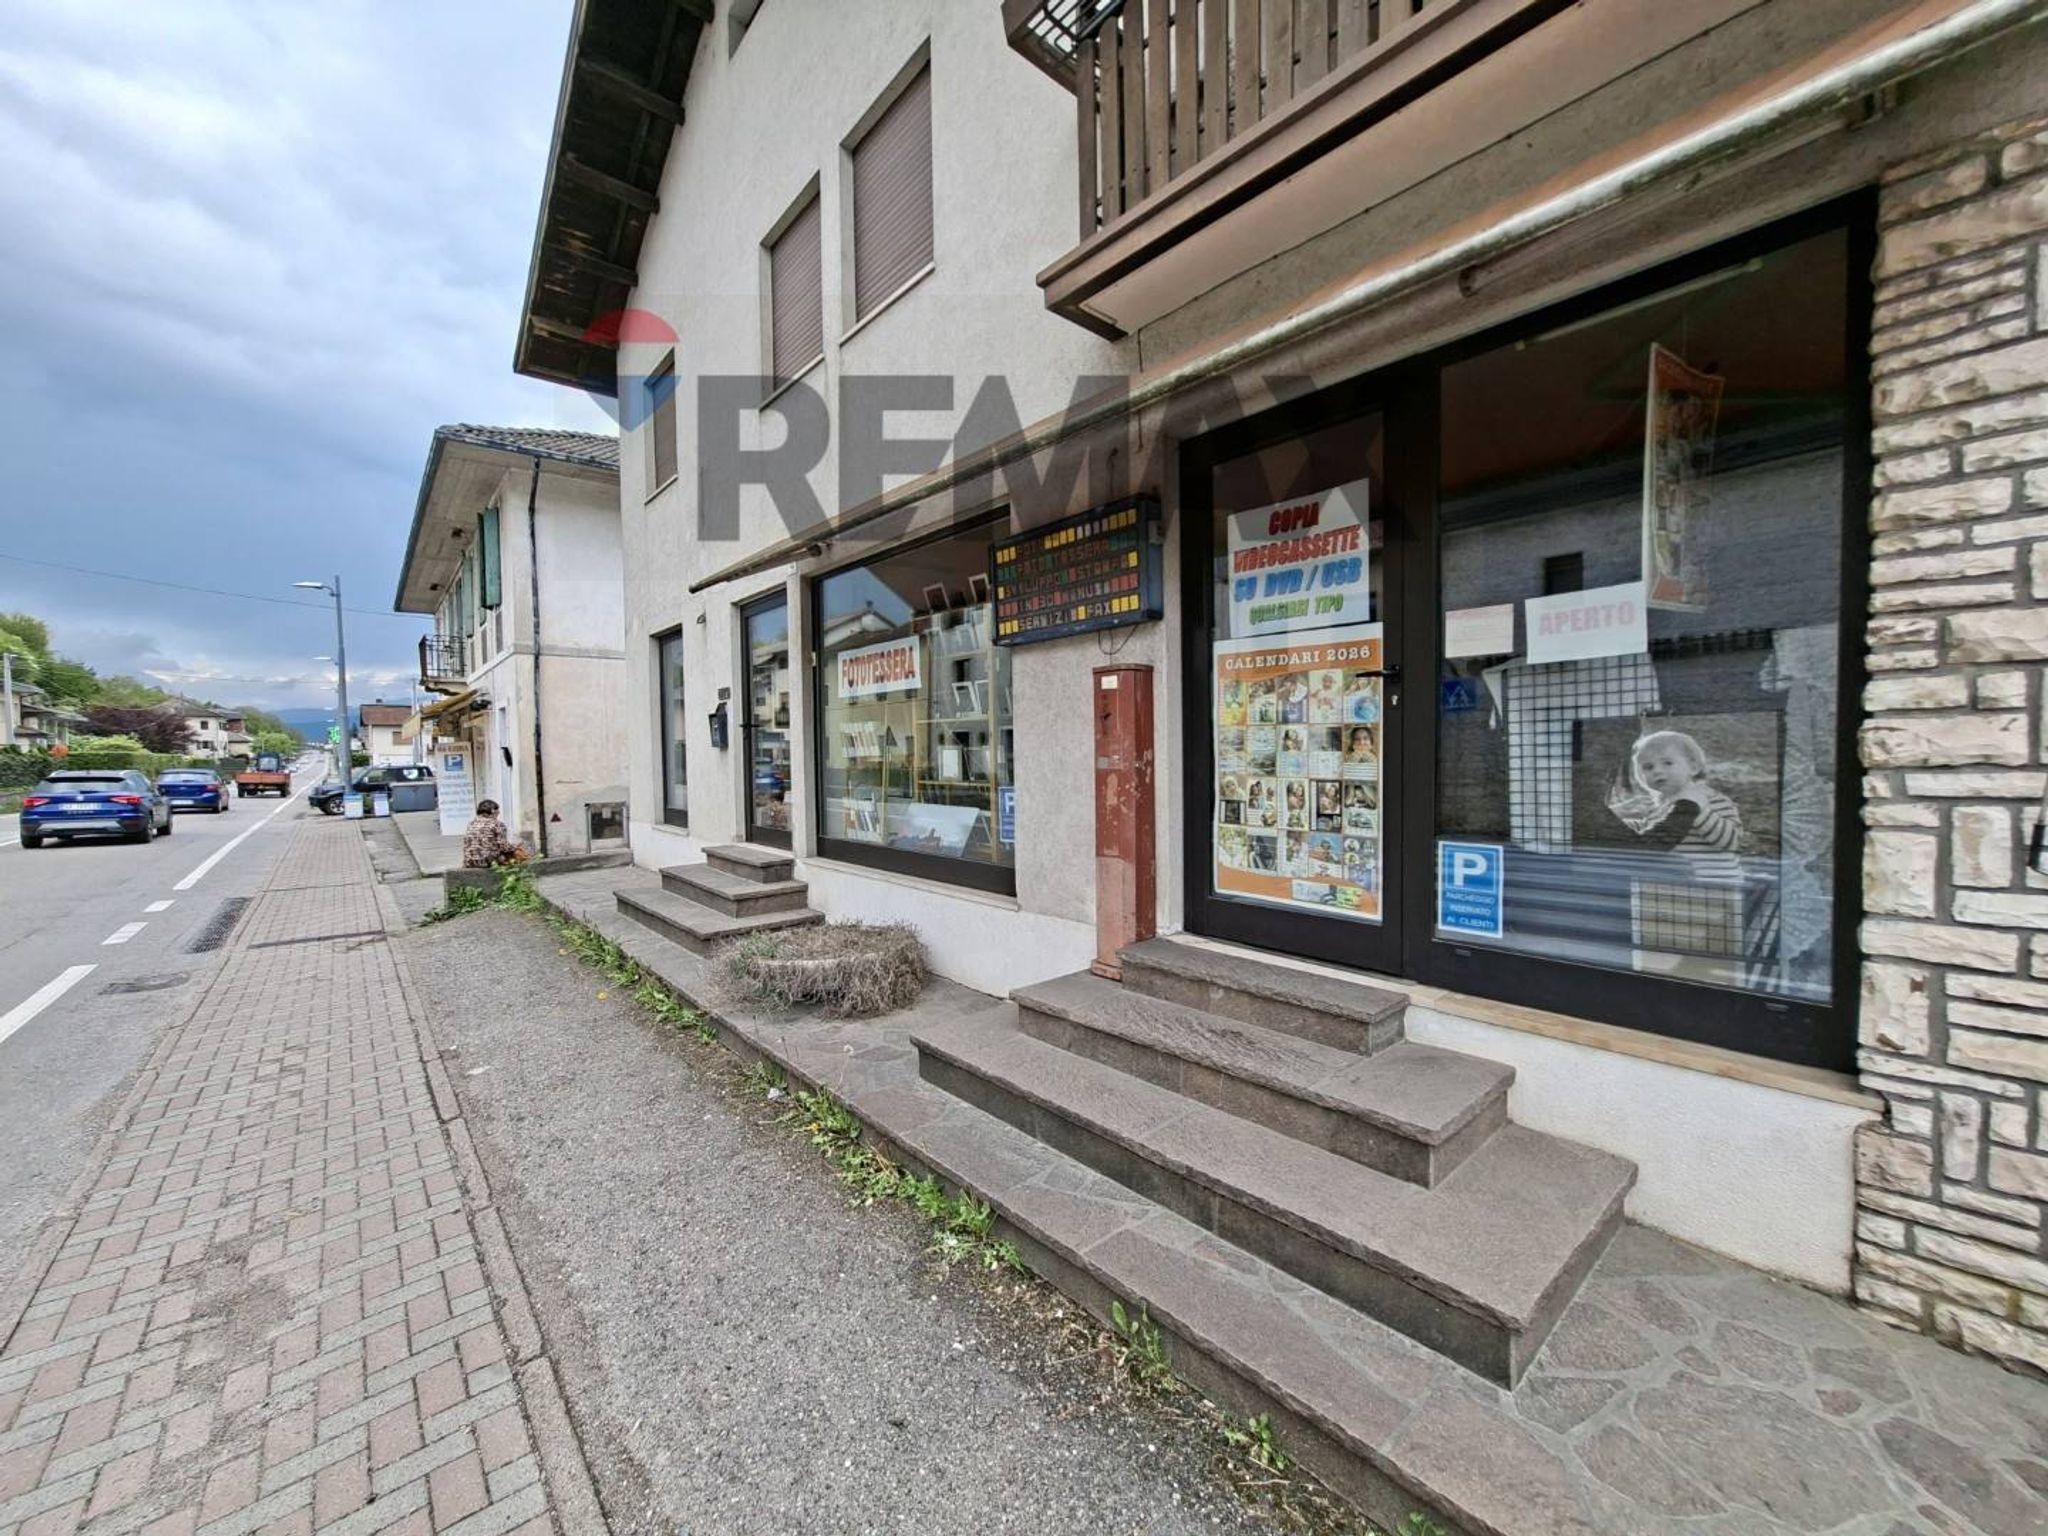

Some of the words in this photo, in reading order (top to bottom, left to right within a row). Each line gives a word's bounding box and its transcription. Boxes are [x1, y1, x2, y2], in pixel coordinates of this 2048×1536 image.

[1268, 501, 1320, 536] COPIA
[1233, 523, 1362, 574] VIDEOCASSETTE
[1234, 576, 1258, 603] SU
[1263, 567, 1305, 598] DVD
[1321, 557, 1363, 588] USB
[1087, 601, 1111, 617] FAX
[1314, 593, 1345, 616] TIPO
[1538, 601, 1636, 637] APERTO
[842, 646, 915, 689] FOTOTESSERA
[1225, 651, 1321, 671] CALENDARI
[1327, 645, 1371, 661] 2026
[1453, 852, 1488, 887] P
